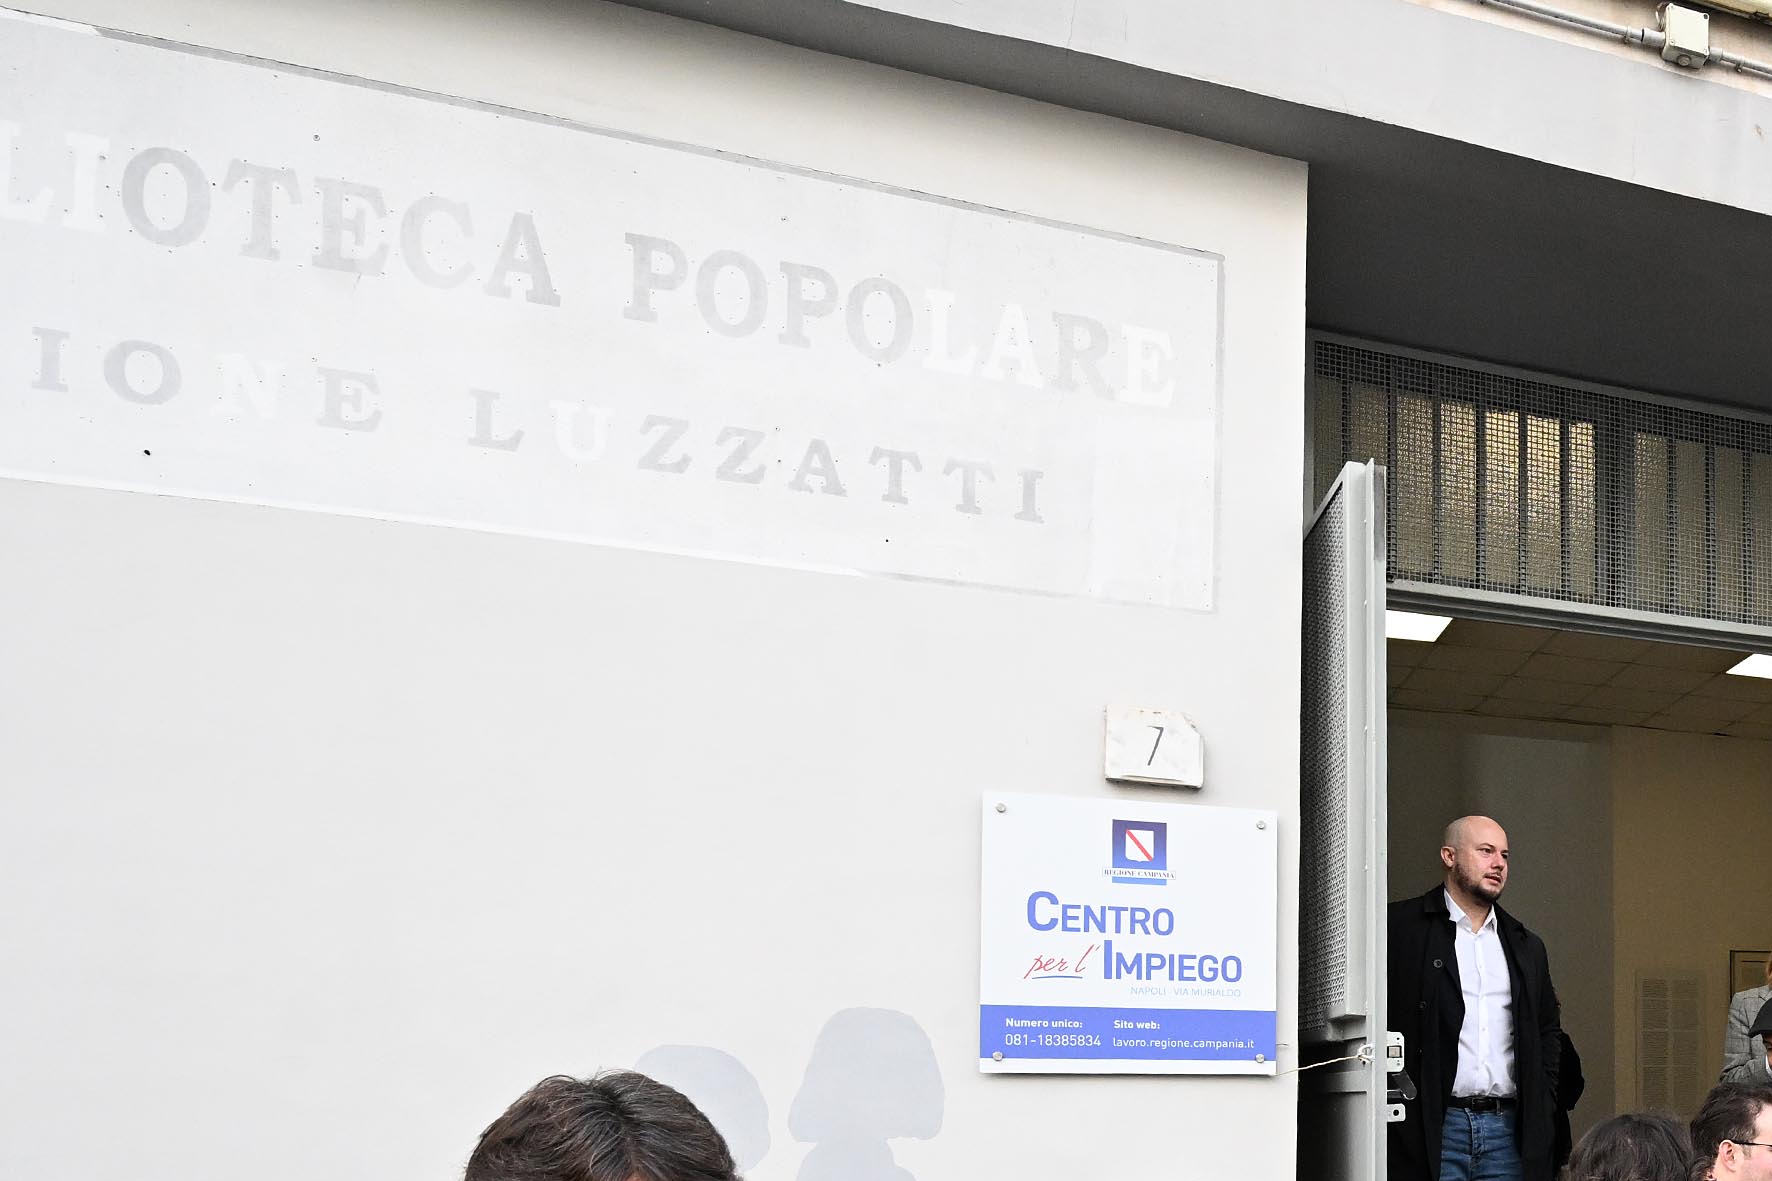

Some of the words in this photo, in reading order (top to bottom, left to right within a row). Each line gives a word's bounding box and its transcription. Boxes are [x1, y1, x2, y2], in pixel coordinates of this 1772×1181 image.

[622, 232, 1178, 408] POPOLARE
[31, 326, 383, 434] IONE
[467, 387, 1045, 525] LUZZATTI
[1147, 725, 1164, 766] 7
[1027, 890, 1175, 936] CENTRO
[1024, 954, 1068, 980] per
[1103, 939, 1242, 983] IMPIEGO
[1130, 986, 1166, 996] NAPOLI
[1173, 987, 1189, 996] VIA
[1005, 1017, 1049, 1028] Numero
[1051, 1017, 1083, 1029] unico:
[1113, 1019, 1134, 1029] Sito
[1135, 1019, 1160, 1030] web:
[1005, 1033, 1101, 1047] 081-18385834
[1113, 1036, 1255, 1050] lavoro.regione.campania.it
